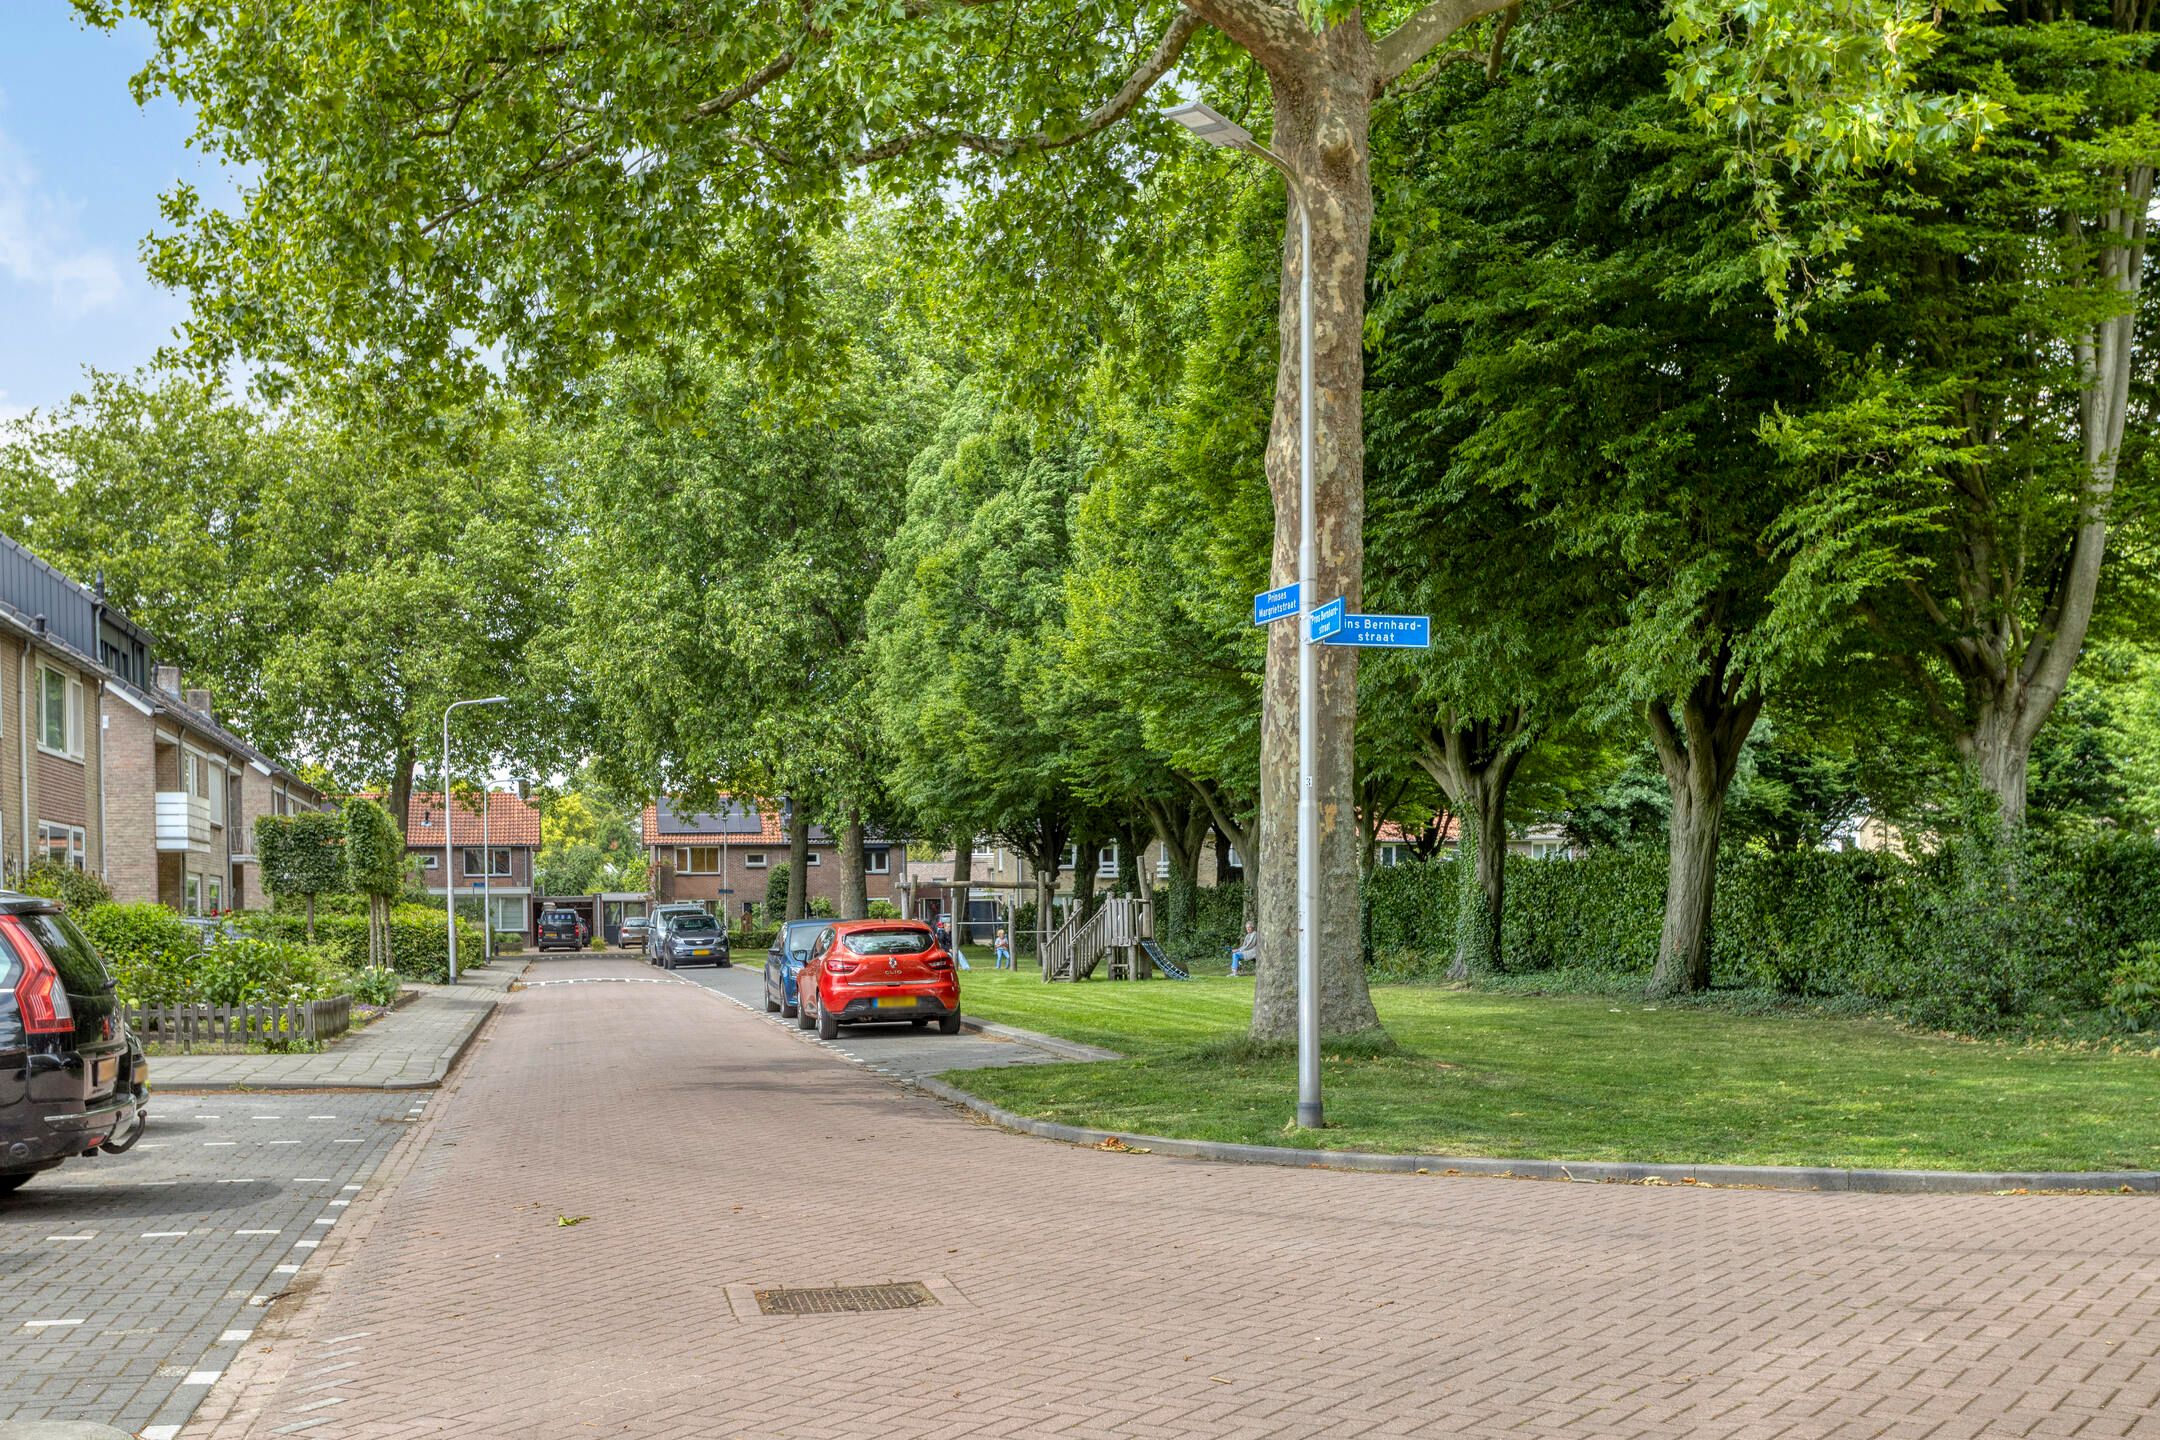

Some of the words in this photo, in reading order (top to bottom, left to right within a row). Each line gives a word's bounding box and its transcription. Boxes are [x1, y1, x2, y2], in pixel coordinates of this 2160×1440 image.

[1267, 591, 1287, 603] Prinses
[1258, 597, 1297, 618] Margrietstraat
[1318, 621, 1331, 635] straat
[1344, 618, 1360, 629] ins
[1364, 619, 1422, 631] Bernhard-
[1357, 631, 1395, 642] straat
